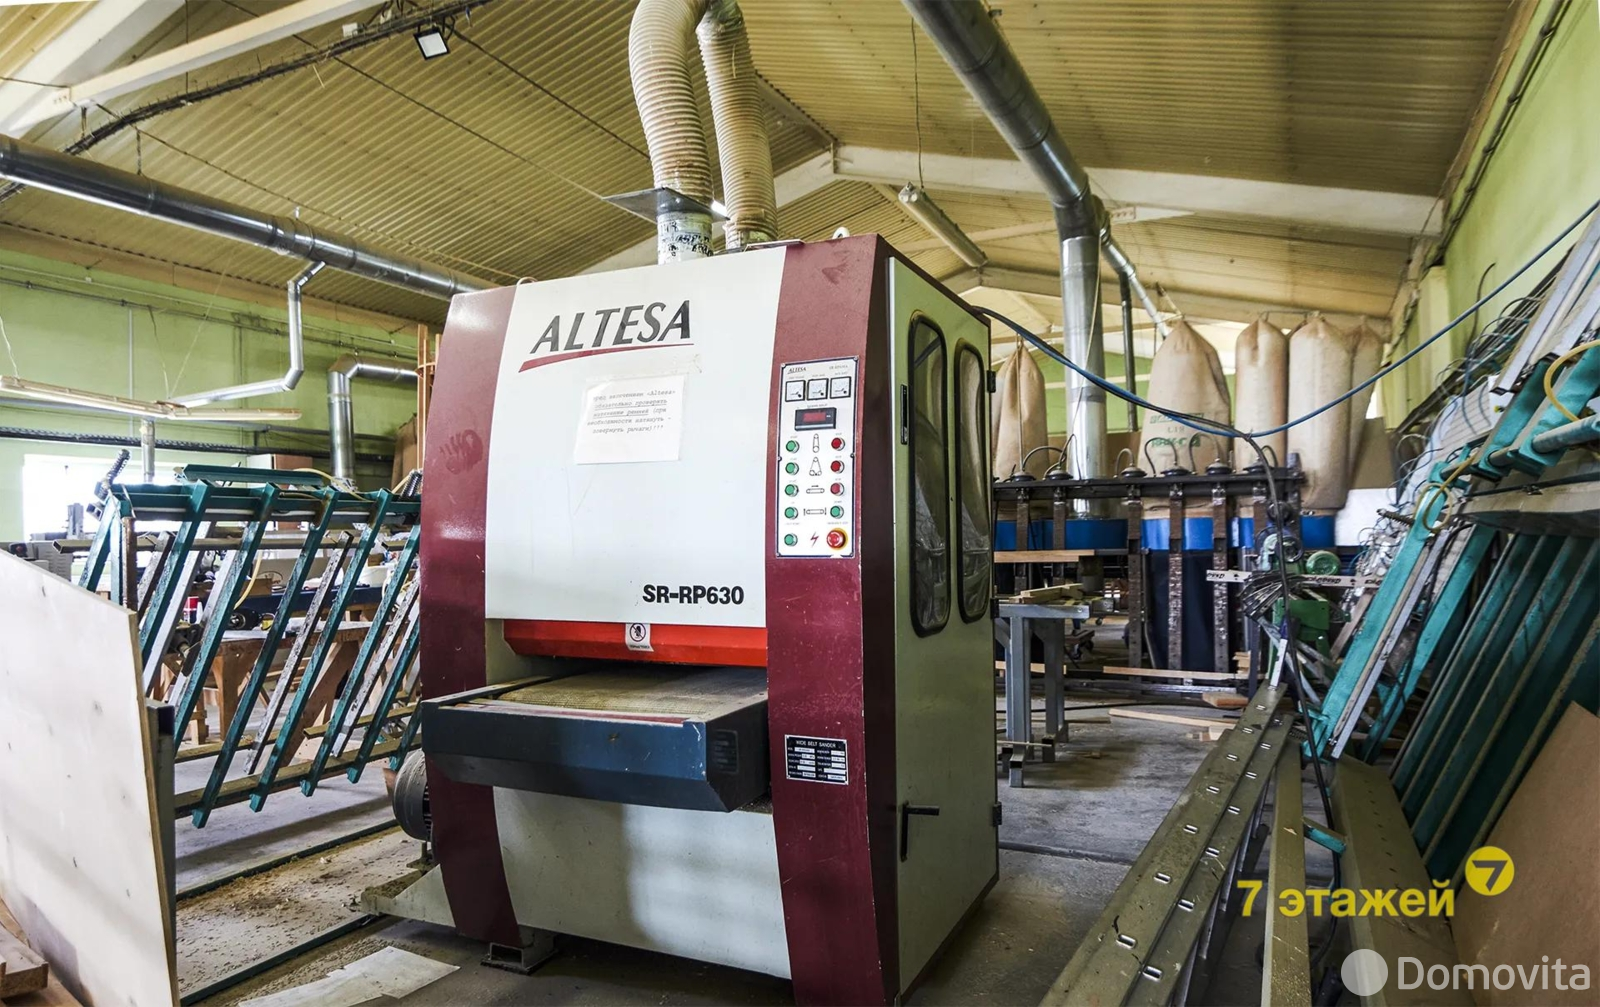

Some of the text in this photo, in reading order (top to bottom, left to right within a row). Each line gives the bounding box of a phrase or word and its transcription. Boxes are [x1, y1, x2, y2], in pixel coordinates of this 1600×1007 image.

[530, 300, 691, 354] ALTESA
[788, 366, 807, 374] ALTESA
[609, 391, 644, 399] включением
[594, 399, 668, 409] обязательно проверить
[626, 408, 649, 416] ремней
[587, 418, 632, 426] необходимости
[635, 416, 664, 424] натянуть
[592, 426, 624, 434] повернуть
[642, 584, 744, 605] SR-RP630
